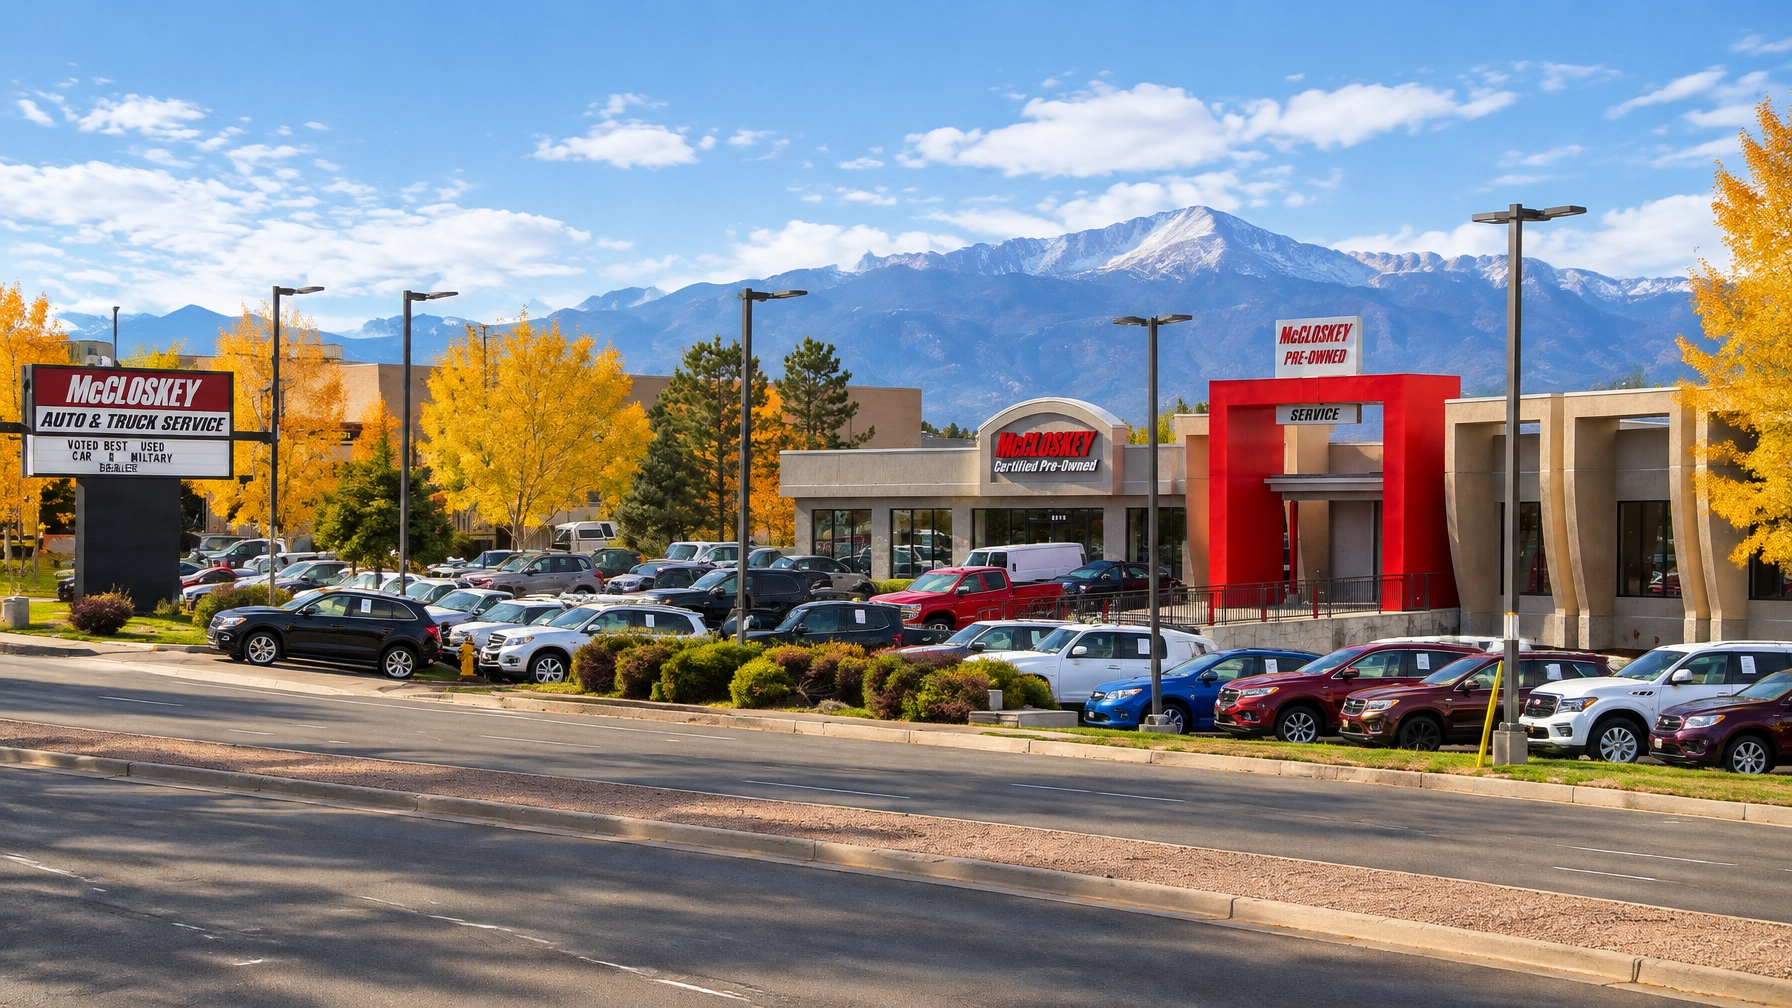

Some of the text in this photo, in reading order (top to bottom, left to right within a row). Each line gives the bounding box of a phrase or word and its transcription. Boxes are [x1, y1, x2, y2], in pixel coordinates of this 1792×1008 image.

[1279, 323, 1353, 344] McCLOSKEY
[1283, 349, 1347, 365] PRE-OWNED
[66, 374, 202, 407] McCLOSKEY
[40, 412, 226, 432] AUTO & TRUCK SERVICE
[1290, 408, 1340, 421] SERVICE
[67, 440, 165, 452] VOTED BEST USED
[995, 430, 1097, 458] McCLOSKEY
[72, 451, 92, 461] CAR
[994, 459, 1098, 472] Certified Pre-Owned
